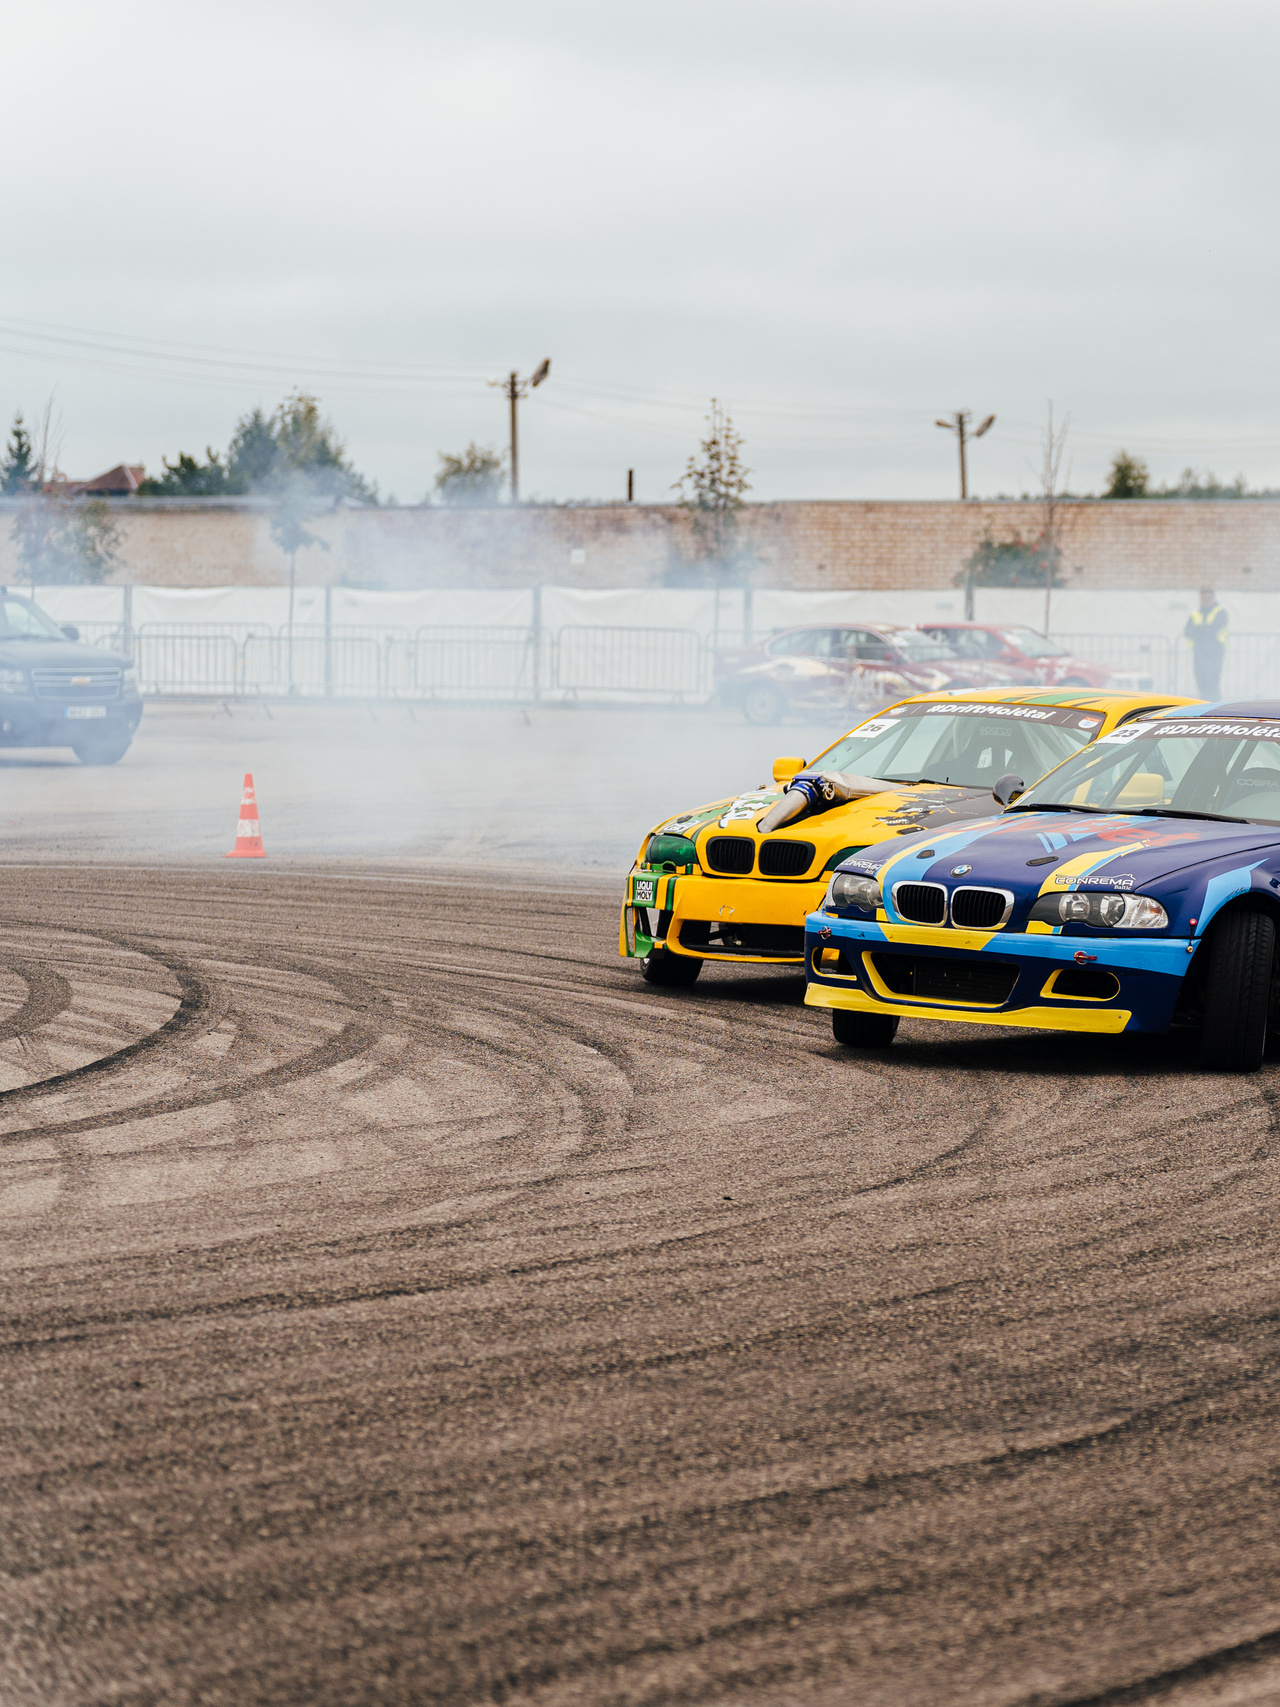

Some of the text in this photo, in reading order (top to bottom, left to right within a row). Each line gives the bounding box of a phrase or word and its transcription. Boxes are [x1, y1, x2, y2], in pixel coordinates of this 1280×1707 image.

[926, 704, 1057, 720] #DriftMolétai
[859, 723, 883, 733] 26
[979, 726, 1012, 736] sparco
[1110, 729, 1140, 738] 23
[1236, 777, 1279, 788] COBRA
[636, 880, 654, 891] LIQUI
[1055, 877, 1134, 887] CONREMA
[636, 890, 653, 901] MOLY
